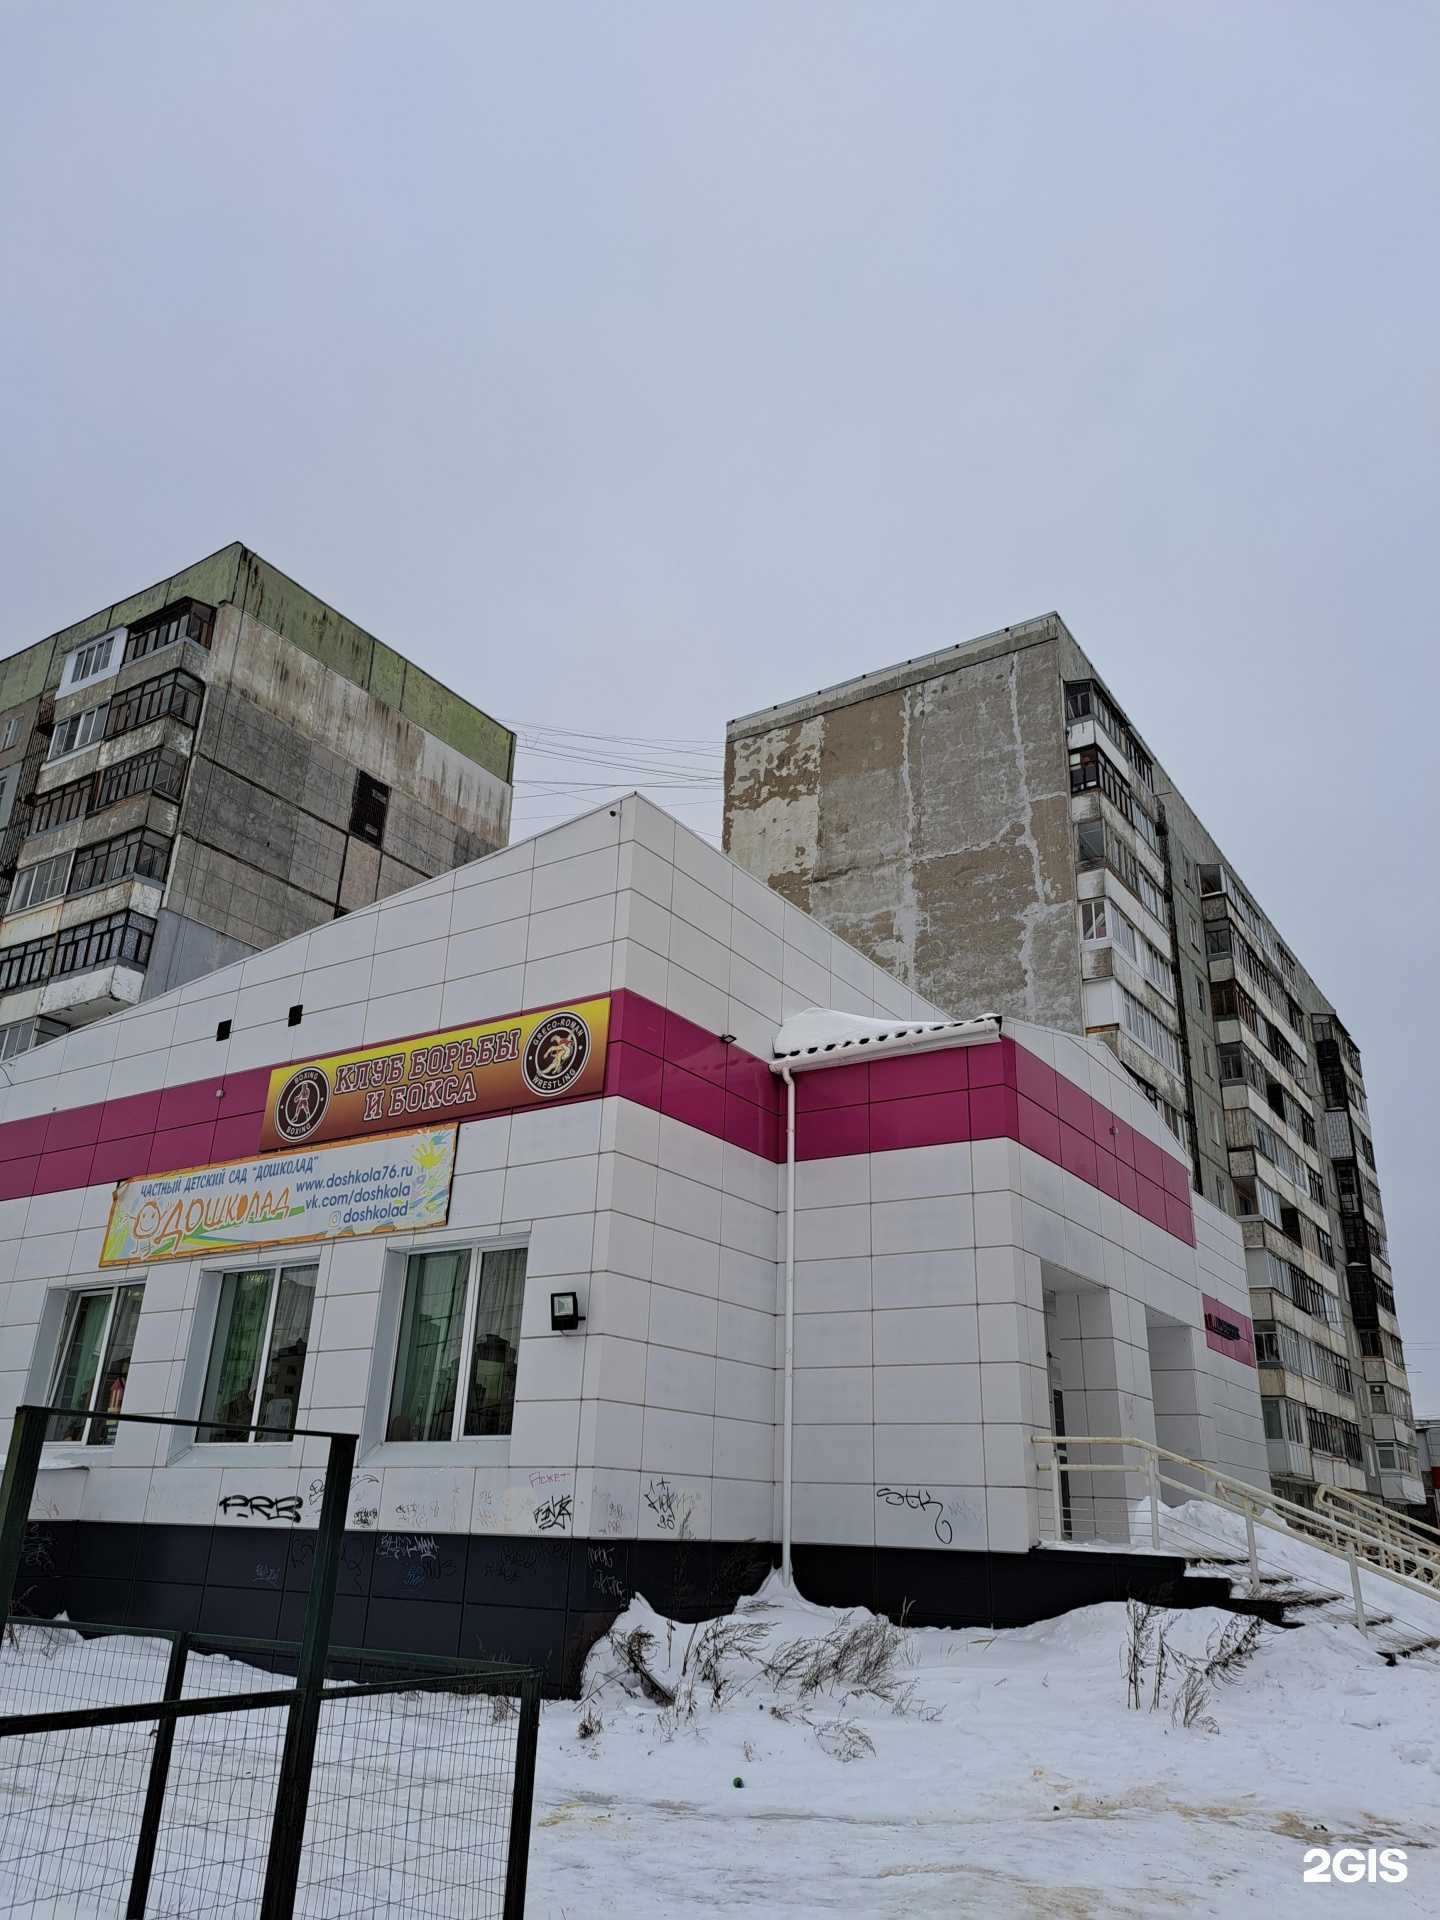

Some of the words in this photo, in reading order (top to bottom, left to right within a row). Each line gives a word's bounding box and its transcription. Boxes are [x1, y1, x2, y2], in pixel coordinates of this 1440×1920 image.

[533, 1018, 584, 1046] GRECO-ROMAN
[334, 1052, 405, 1095] КЛУБ
[409, 1029, 521, 1080] БОРЬБЫ
[293, 1071, 319, 1085] BOXING
[532, 1068, 576, 1090] WRESTLING
[363, 1090, 385, 1121] И
[388, 1073, 477, 1117] БОКСА
[286, 1122, 311, 1136] BOXING
[140, 1175, 182, 1198] ЧАСТНЫЙ
[184, 1168, 226, 1192] ДЕТСКИЙ
[228, 1167, 249, 1184] САД
[296, 1165, 414, 1193] www.doshkola76.ru
[305, 1182, 411, 1210] vk.com/doshkola
